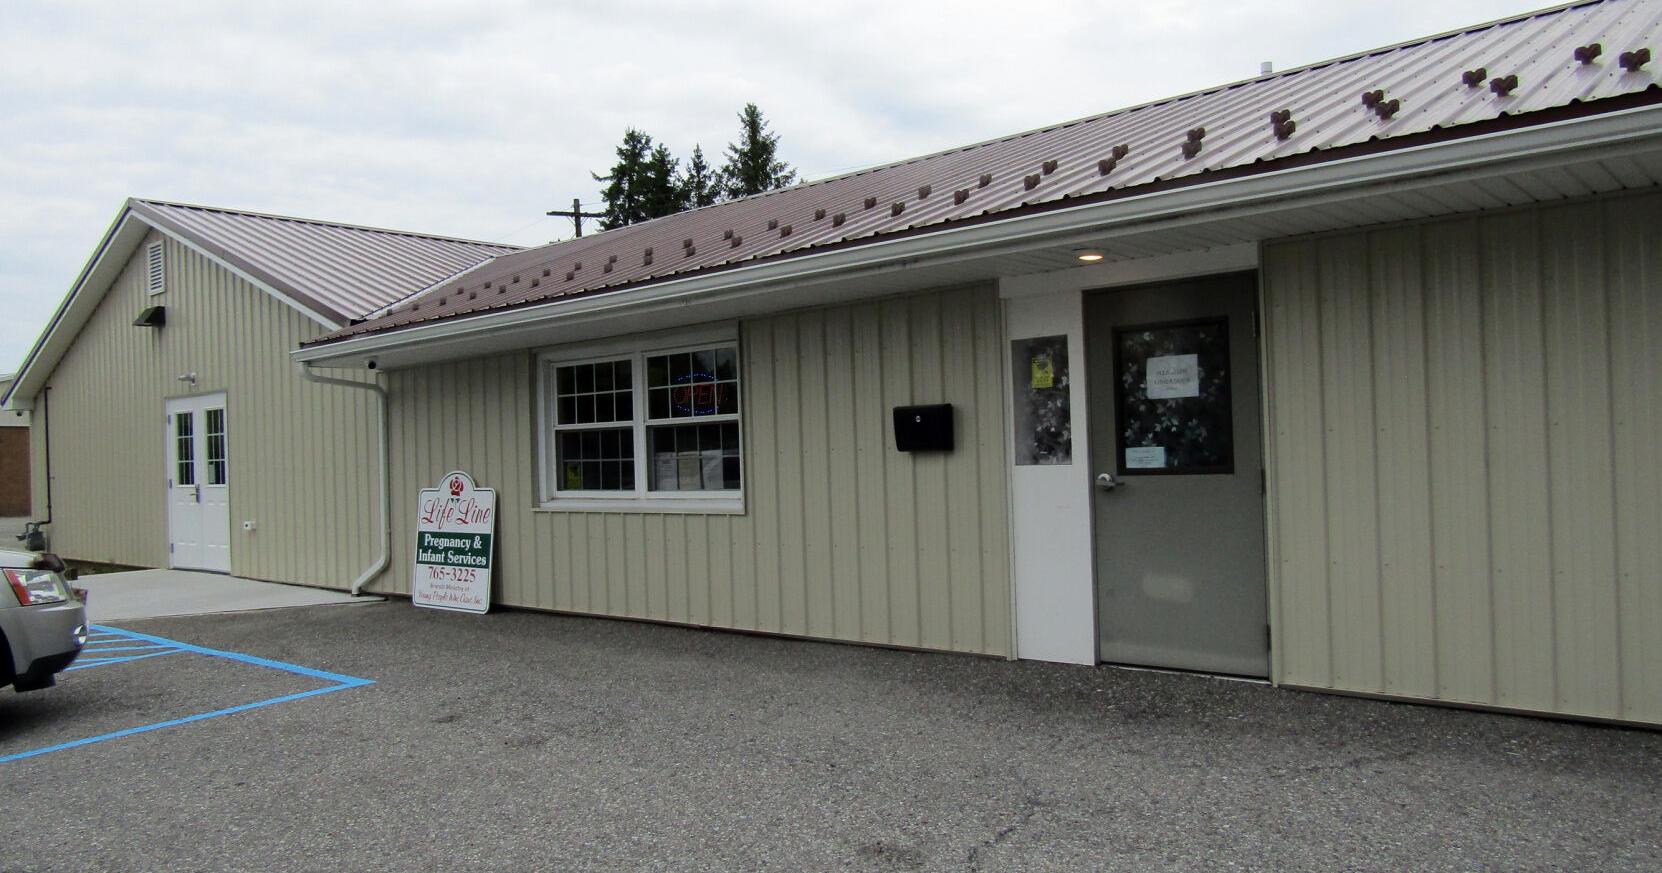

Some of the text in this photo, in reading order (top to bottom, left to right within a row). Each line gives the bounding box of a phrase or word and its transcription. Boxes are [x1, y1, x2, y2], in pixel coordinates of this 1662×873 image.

[673, 383, 727, 405] OPEN
[422, 498, 490, 529] Life Line
[425, 534, 482, 550] Pregnancy &
[418, 549, 487, 566] Infant Services
[428, 566, 476, 582] 765-3225
